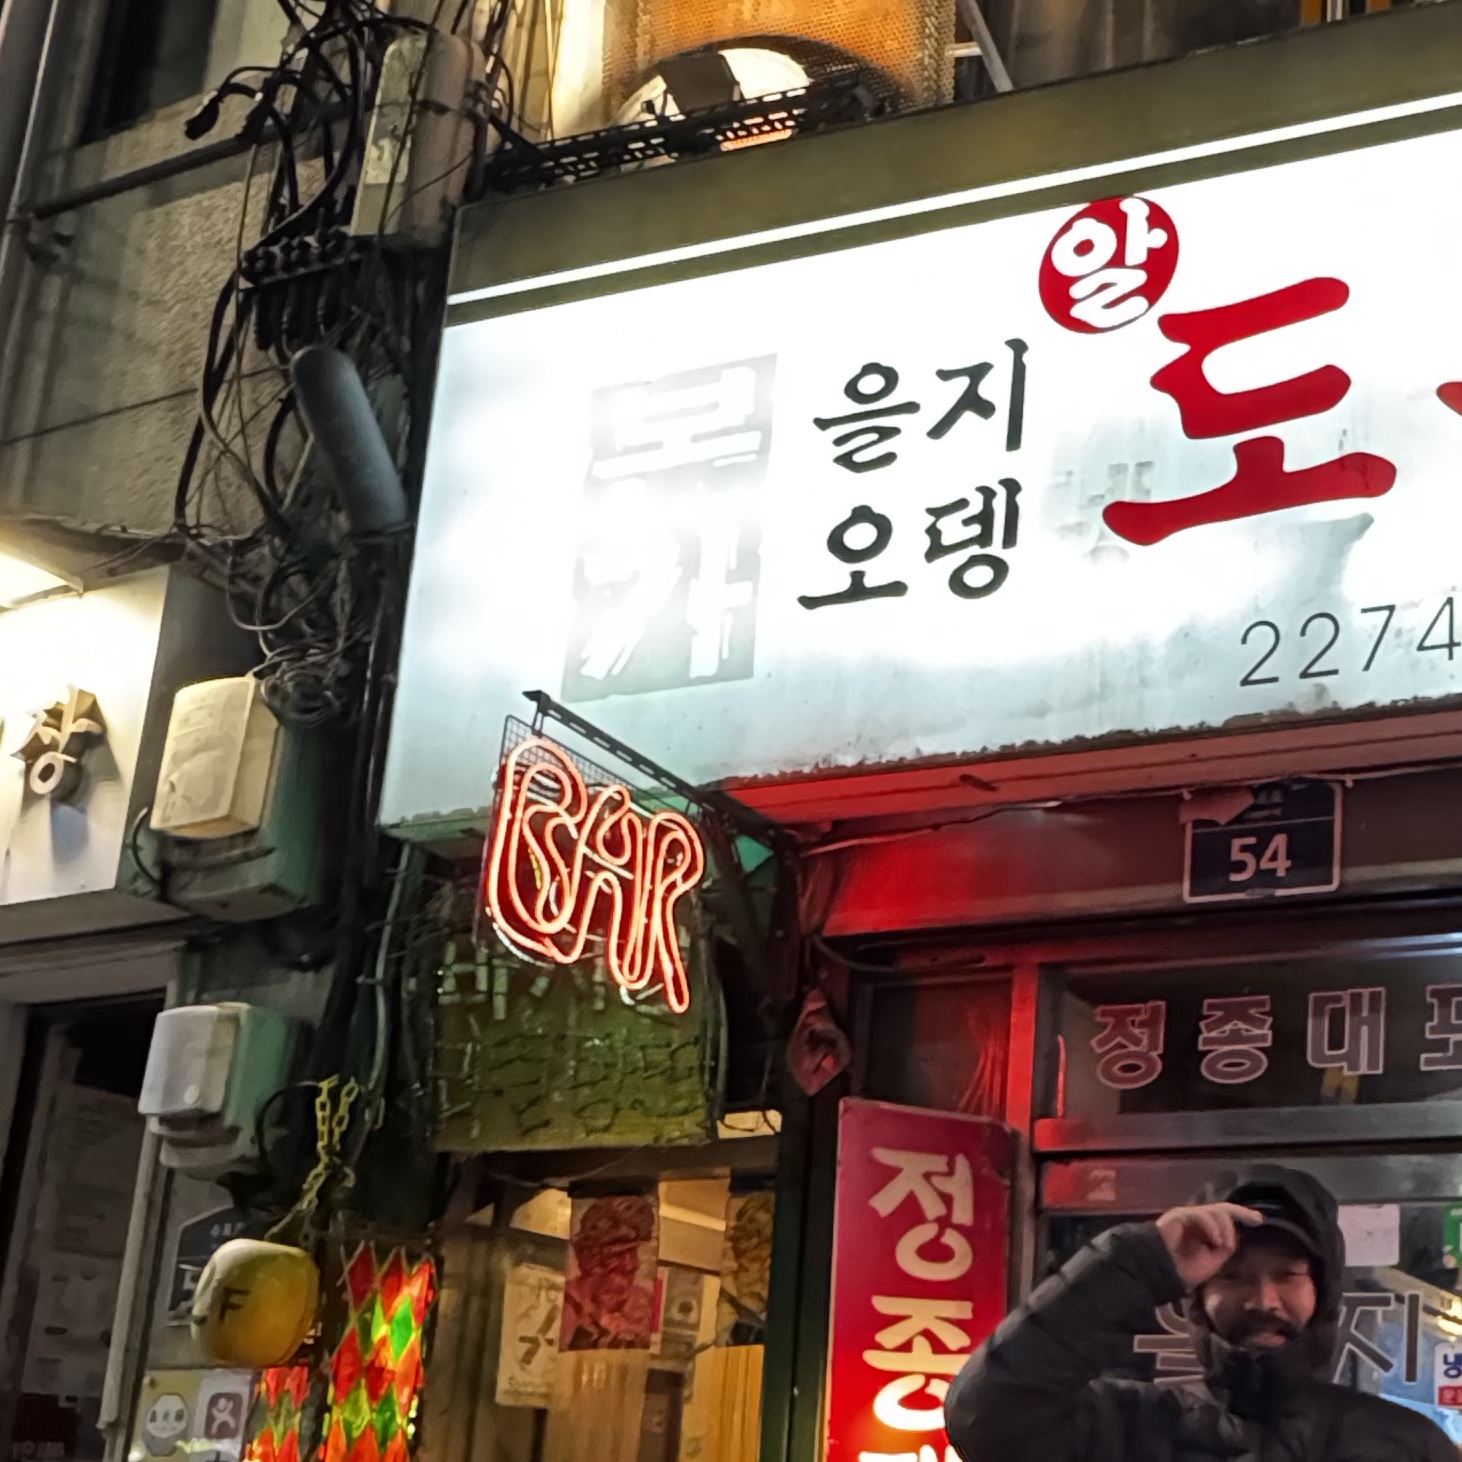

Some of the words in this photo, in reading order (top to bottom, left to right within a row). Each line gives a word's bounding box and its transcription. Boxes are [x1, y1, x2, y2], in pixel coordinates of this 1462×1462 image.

[1051, 198, 1168, 330] 알
[813, 339, 1029, 474] 을지
[797, 479, 1022, 610] 오뎅
[1228, 832, 1292, 882] 54
